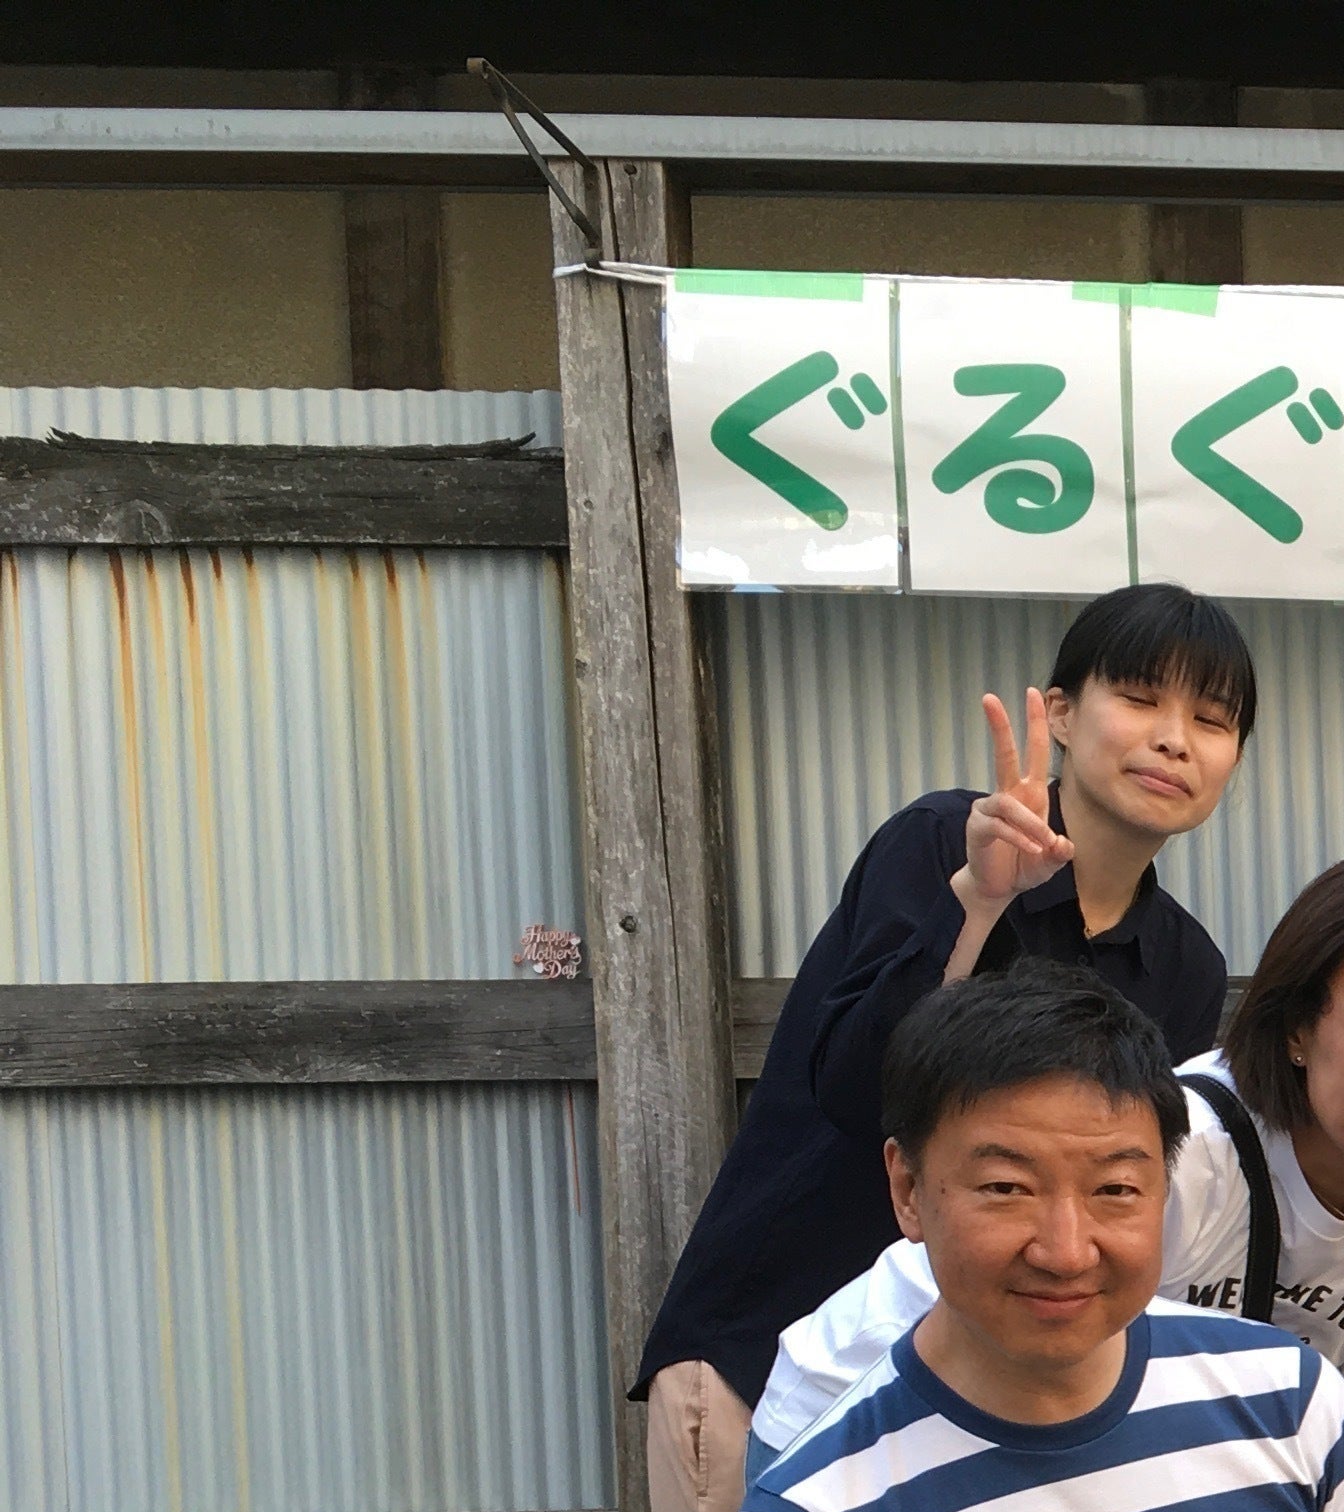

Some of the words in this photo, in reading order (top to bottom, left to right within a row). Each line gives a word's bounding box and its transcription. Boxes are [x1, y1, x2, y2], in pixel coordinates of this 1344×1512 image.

[521, 925, 573, 947] Happy
[523, 943, 581, 965] Mother's
[542, 960, 581, 979] Day
[1187, 1278, 1332, 1313] WEME
